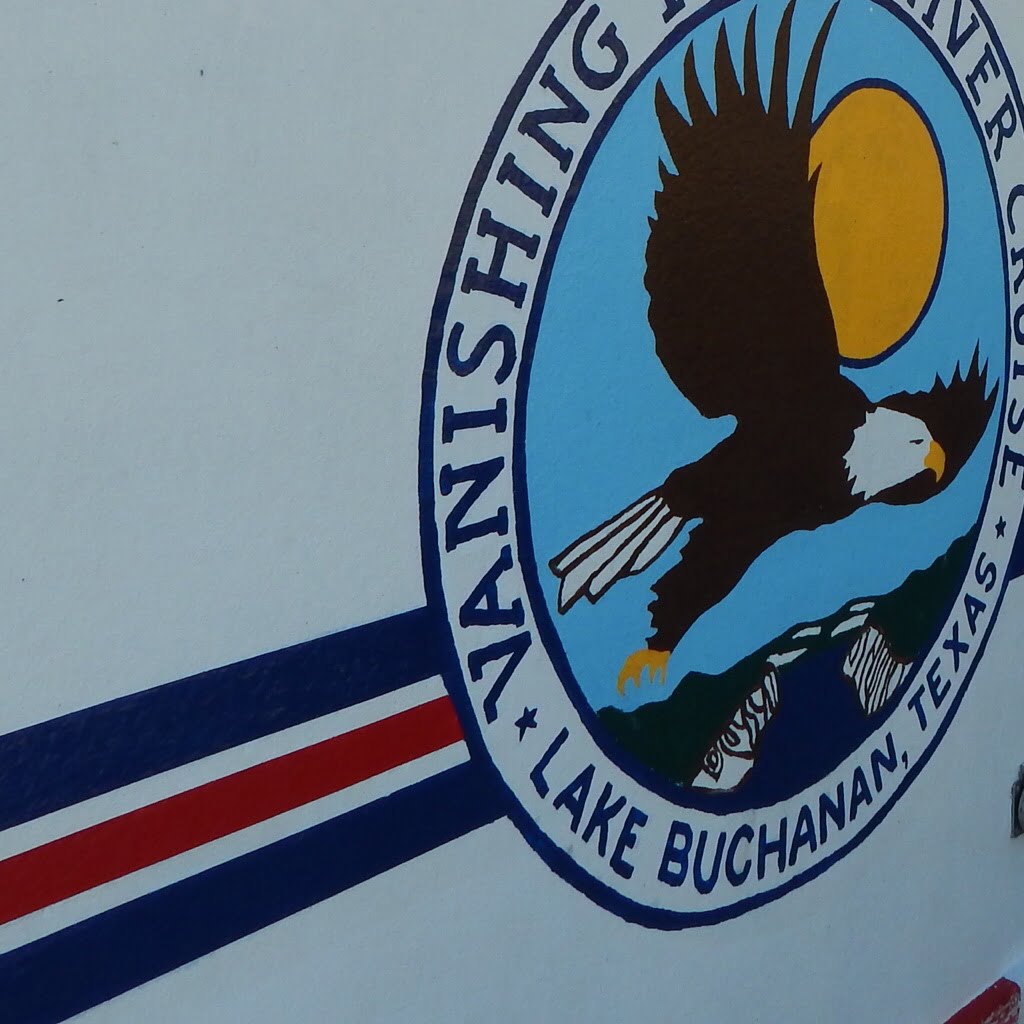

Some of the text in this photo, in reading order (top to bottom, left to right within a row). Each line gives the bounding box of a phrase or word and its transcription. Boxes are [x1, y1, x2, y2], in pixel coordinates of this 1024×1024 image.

[440, 4, 629, 723] VANISHING
[531, 551, 996, 894] LAKE BUCHANAN, TEXAS
